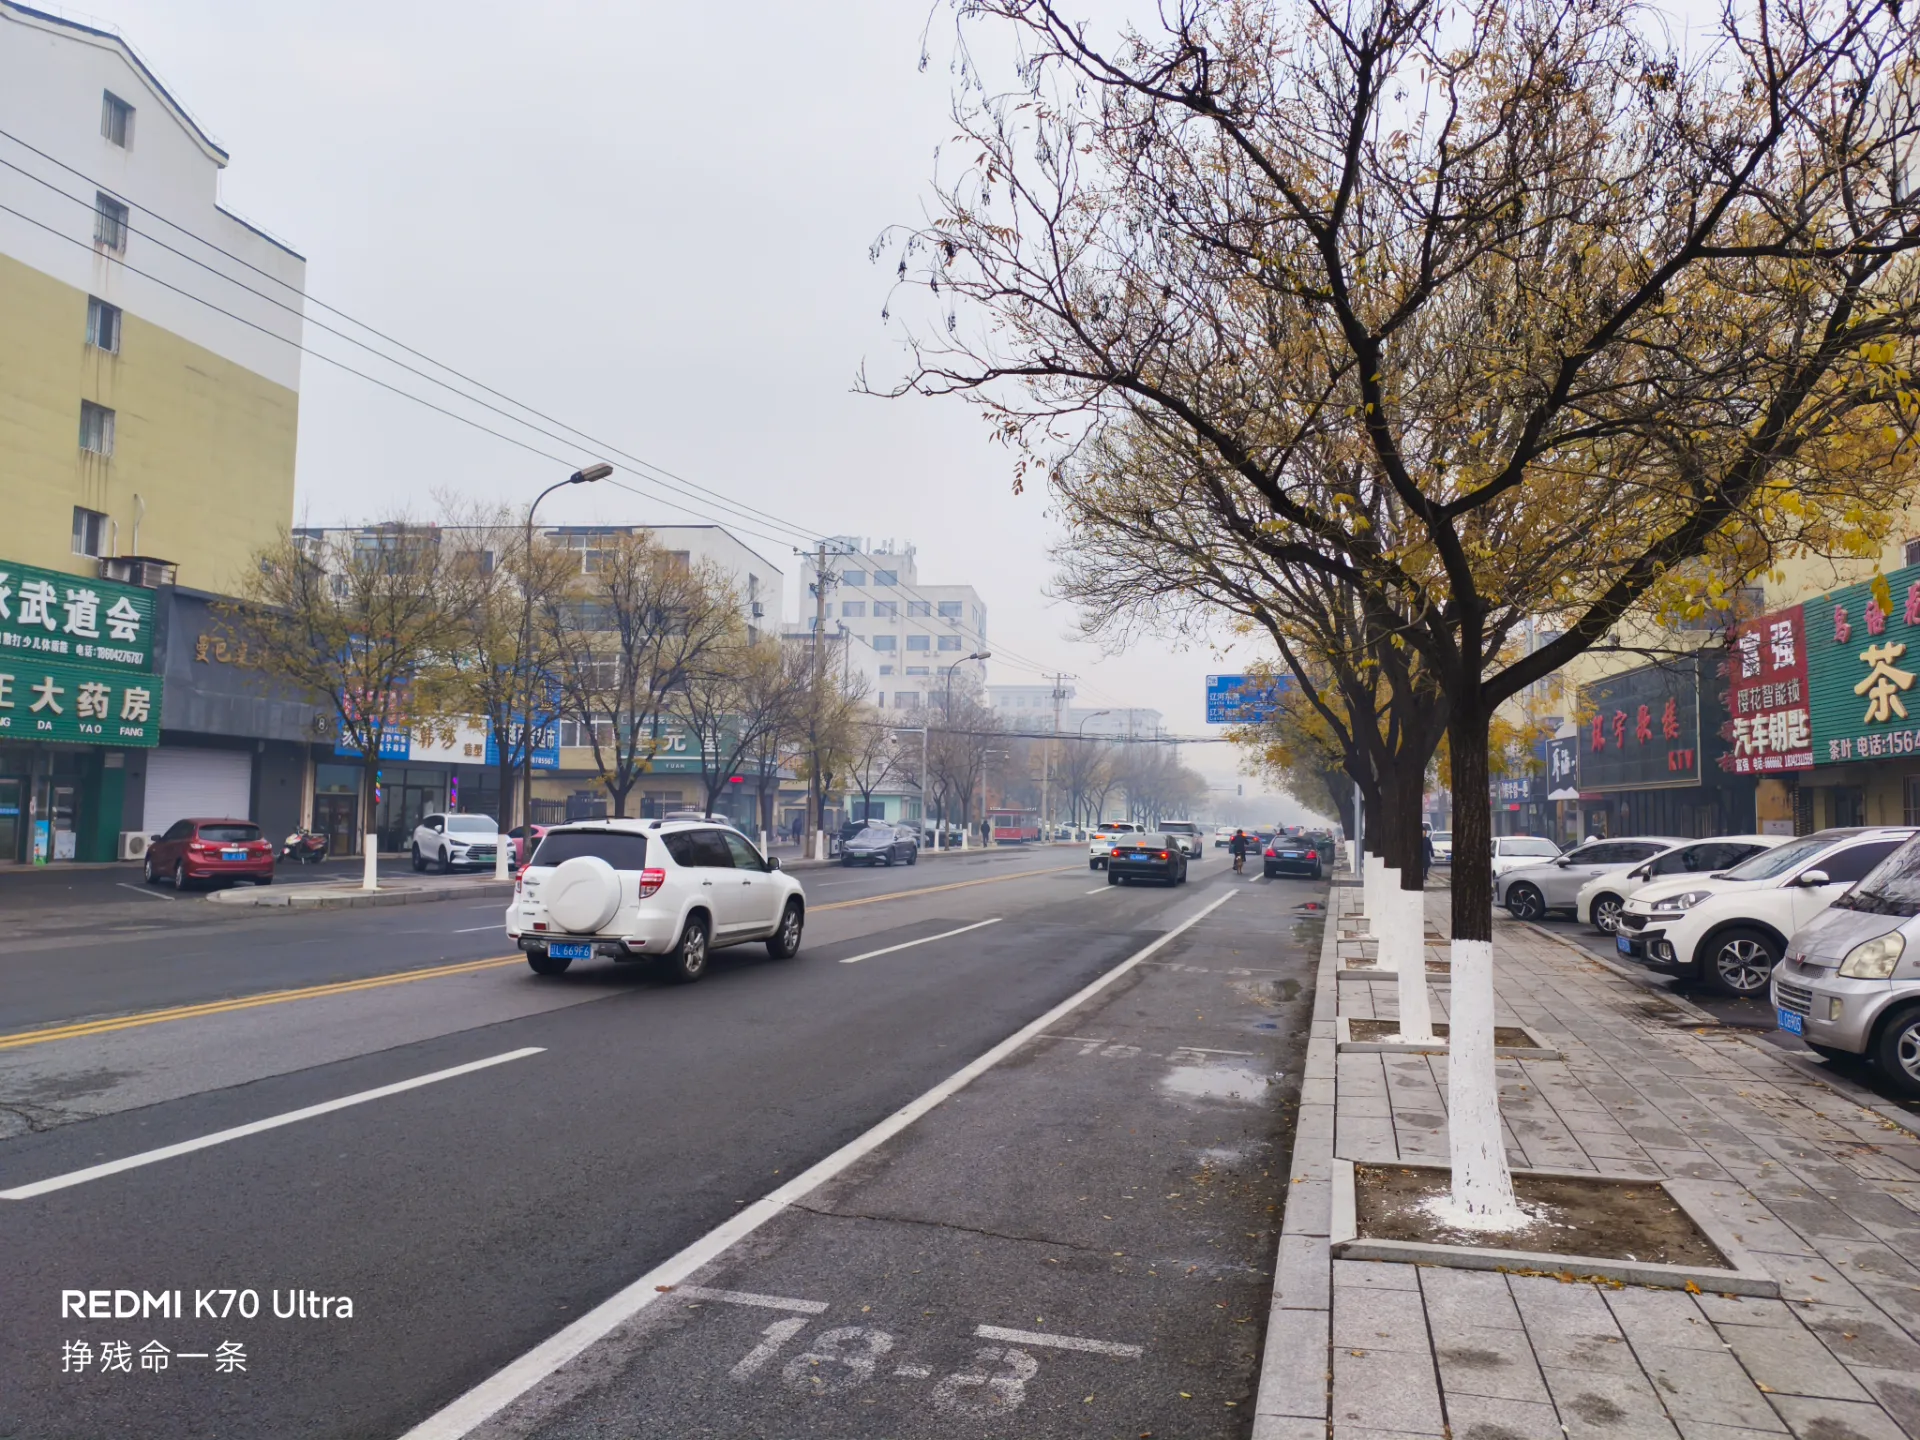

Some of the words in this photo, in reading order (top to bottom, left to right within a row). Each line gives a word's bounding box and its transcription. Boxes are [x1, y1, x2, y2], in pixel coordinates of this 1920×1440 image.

[1739, 620, 1796, 679] 富强
[1854, 641, 1917, 723] 茶
[37, 720, 52, 731] DA
[79, 724, 102, 734] YAO
[119, 727, 143, 737] FANG
[1733, 709, 1810, 758] 汽车钥匙
[1668, 749, 1694, 771] KTV
[1829, 738, 1852, 760] 茶叶
